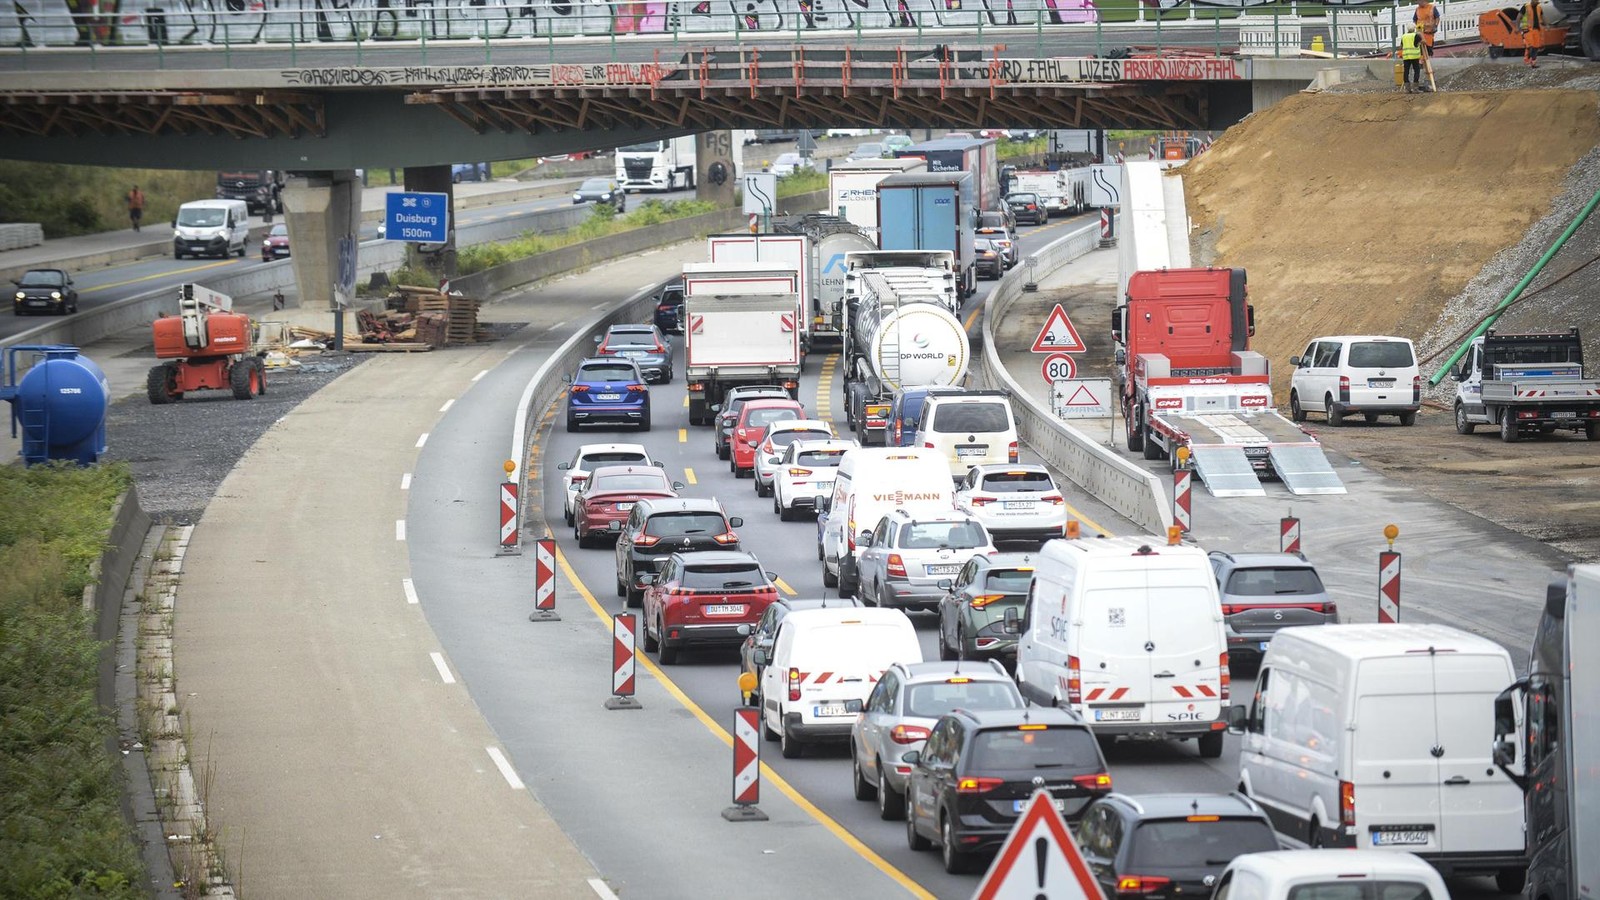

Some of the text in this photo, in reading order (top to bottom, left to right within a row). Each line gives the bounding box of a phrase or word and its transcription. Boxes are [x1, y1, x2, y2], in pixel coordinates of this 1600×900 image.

[395, 213, 438, 226] Duisburg
[1049, 362, 1069, 378] 80
[1242, 398, 1265, 406] GMS
[873, 490, 940, 506] VIESSMANN
[1167, 711, 1205, 721] SPIE
[1403, 831, 1427, 841] 9040
